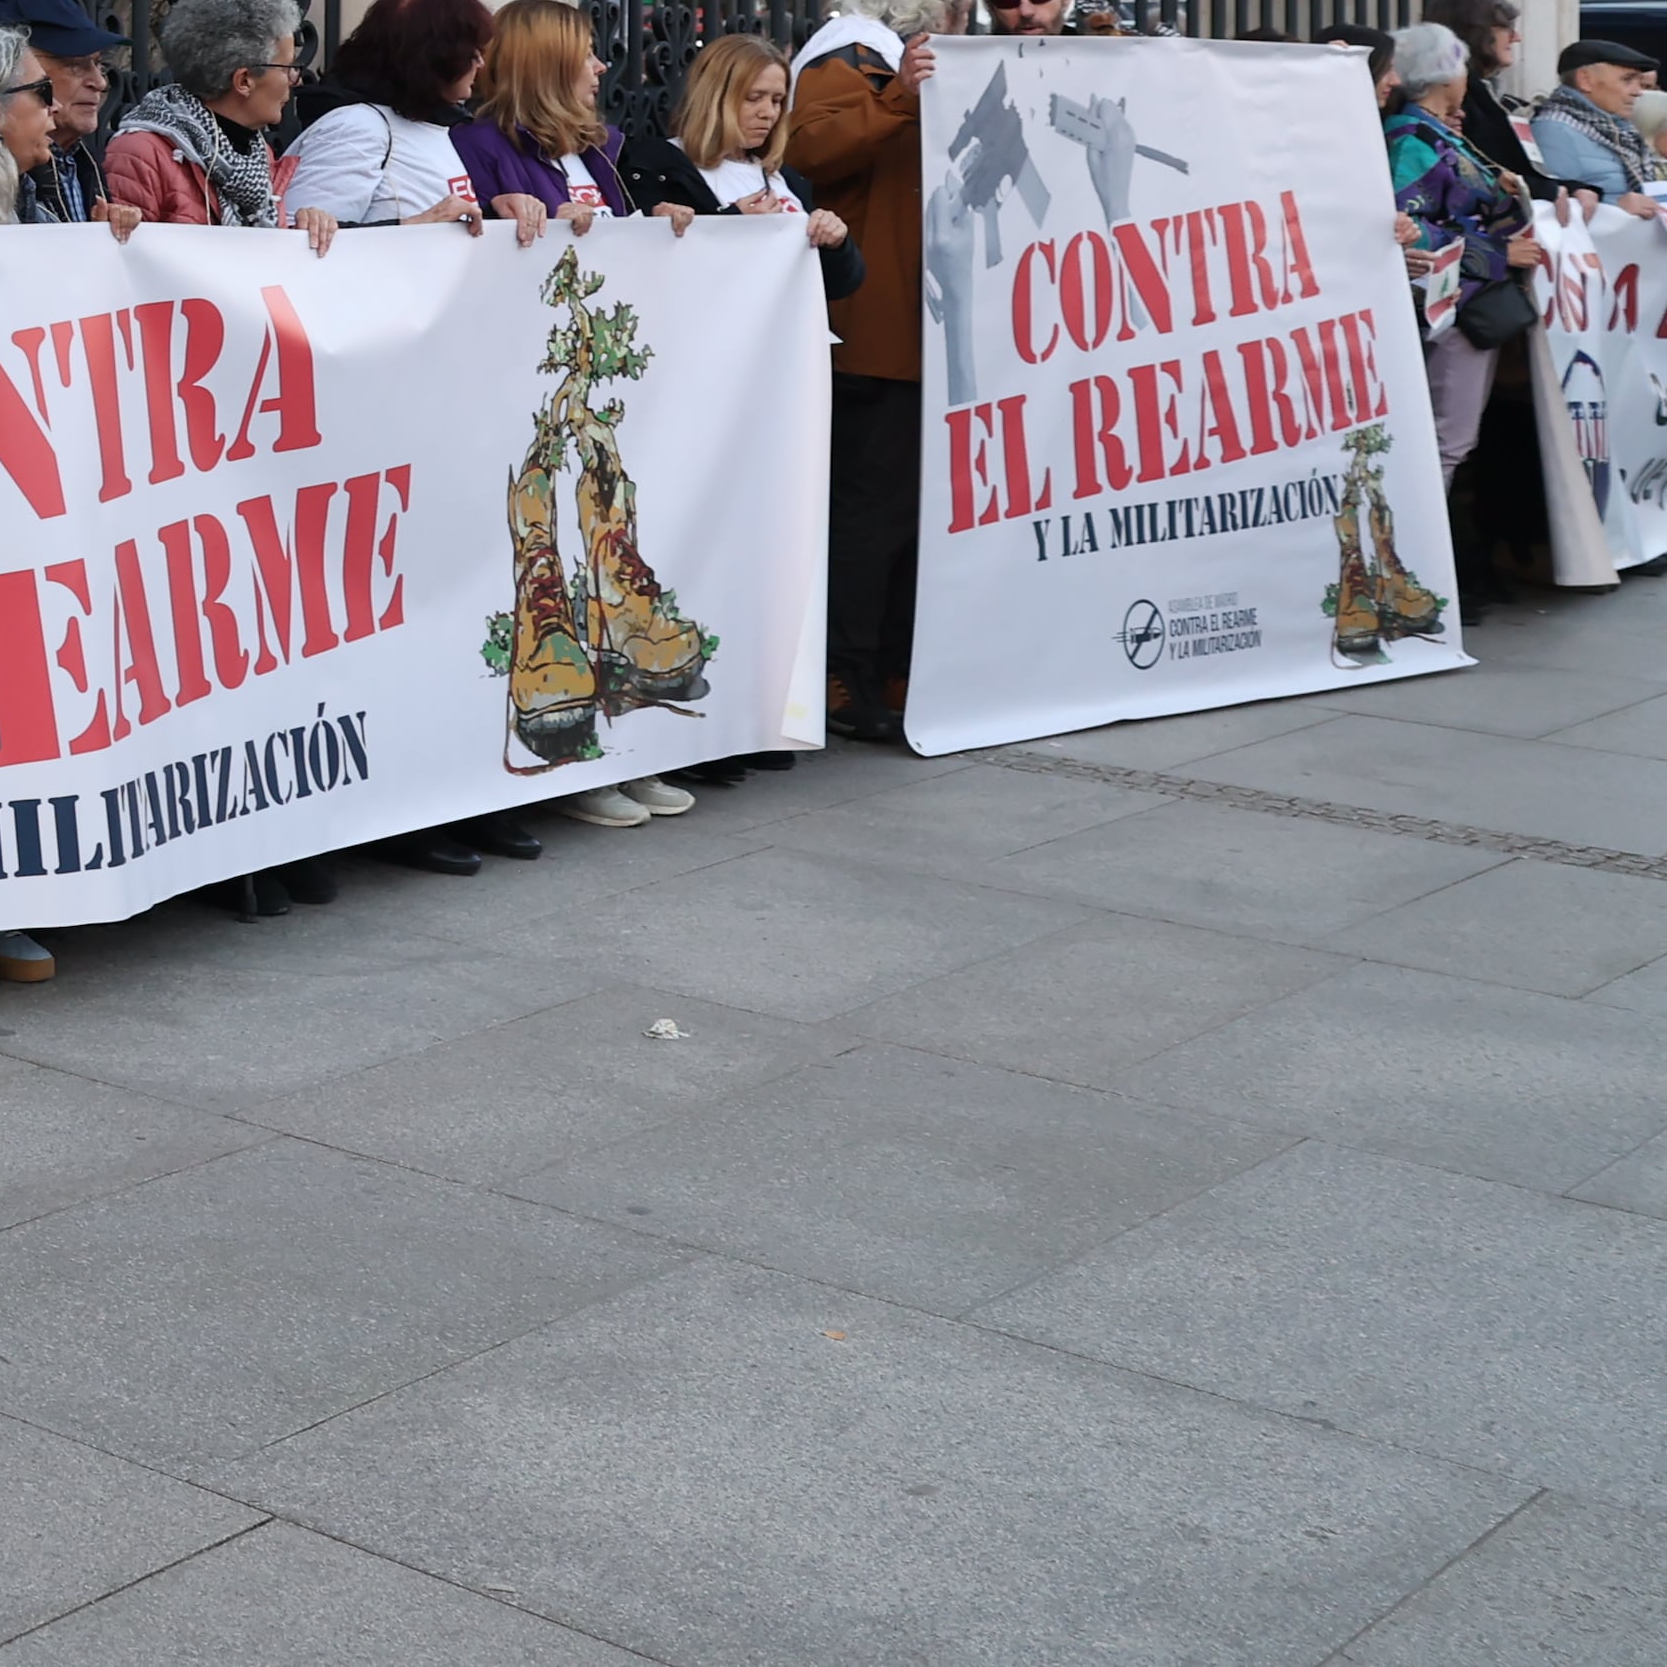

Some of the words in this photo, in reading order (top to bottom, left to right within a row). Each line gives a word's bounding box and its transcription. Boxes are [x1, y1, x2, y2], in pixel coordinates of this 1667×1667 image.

[1010, 189, 1320, 366] CONTRA
[943, 393, 1053, 536] EL
[1068, 307, 1389, 519] REARME
[1033, 519, 1051, 562] Y
[1061, 511, 1099, 557] LA
[1108, 467, 1342, 550] MILITARIZACIÓN
[1169, 642, 1177, 660] Y
[1178, 640, 1190, 659] LA
[1170, 615, 1209, 637] CONTRA
[1210, 613, 1220, 632] EL
[1222, 607, 1258, 632] REARME
